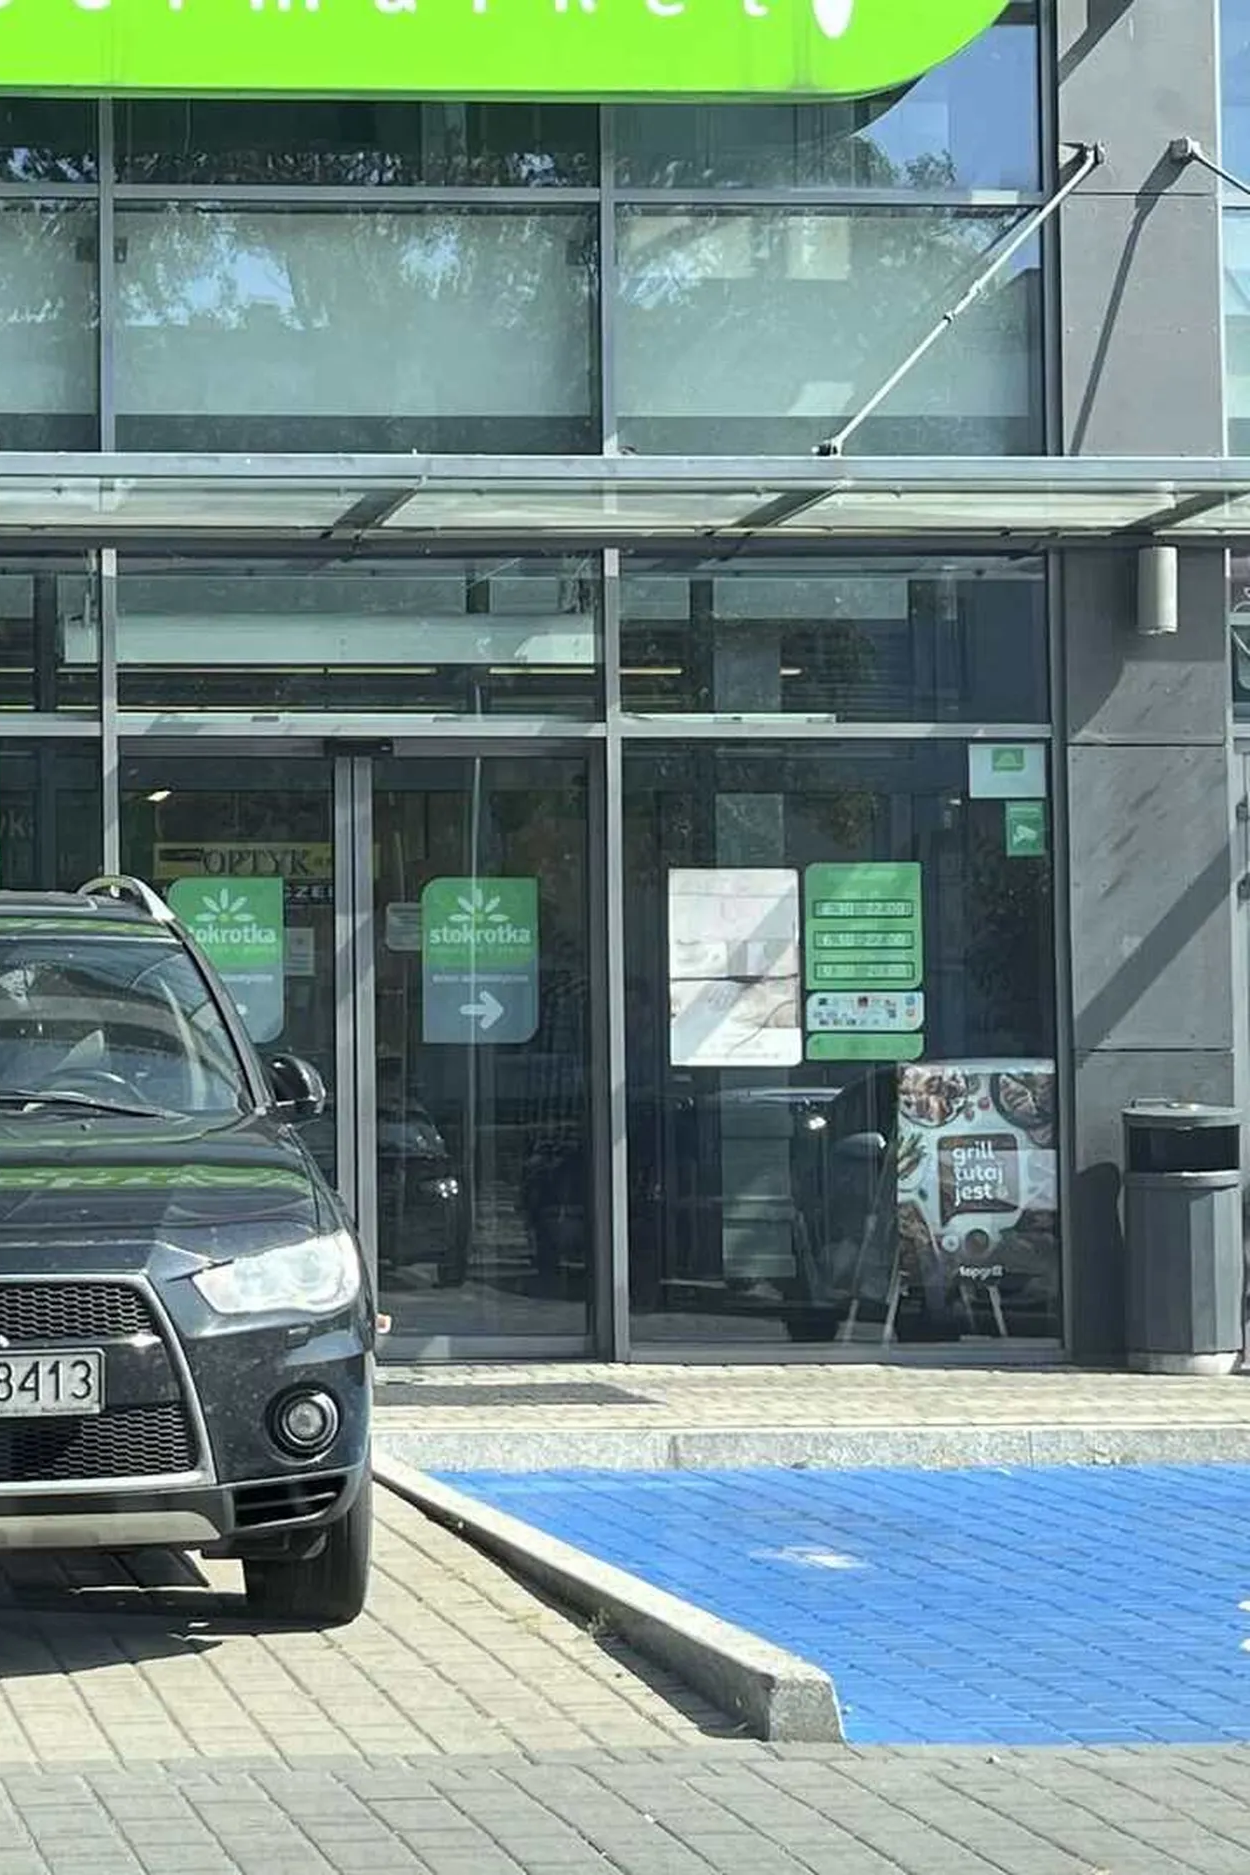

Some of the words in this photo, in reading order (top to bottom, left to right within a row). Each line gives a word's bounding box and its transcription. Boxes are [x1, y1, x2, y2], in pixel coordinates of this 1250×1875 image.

[201, 848, 312, 876] OPTYK
[430, 923, 531, 944] stokrotka
[953, 1140, 996, 1166] grill
[954, 1162, 1003, 1184] tutaj
[955, 1182, 993, 1207] jest
